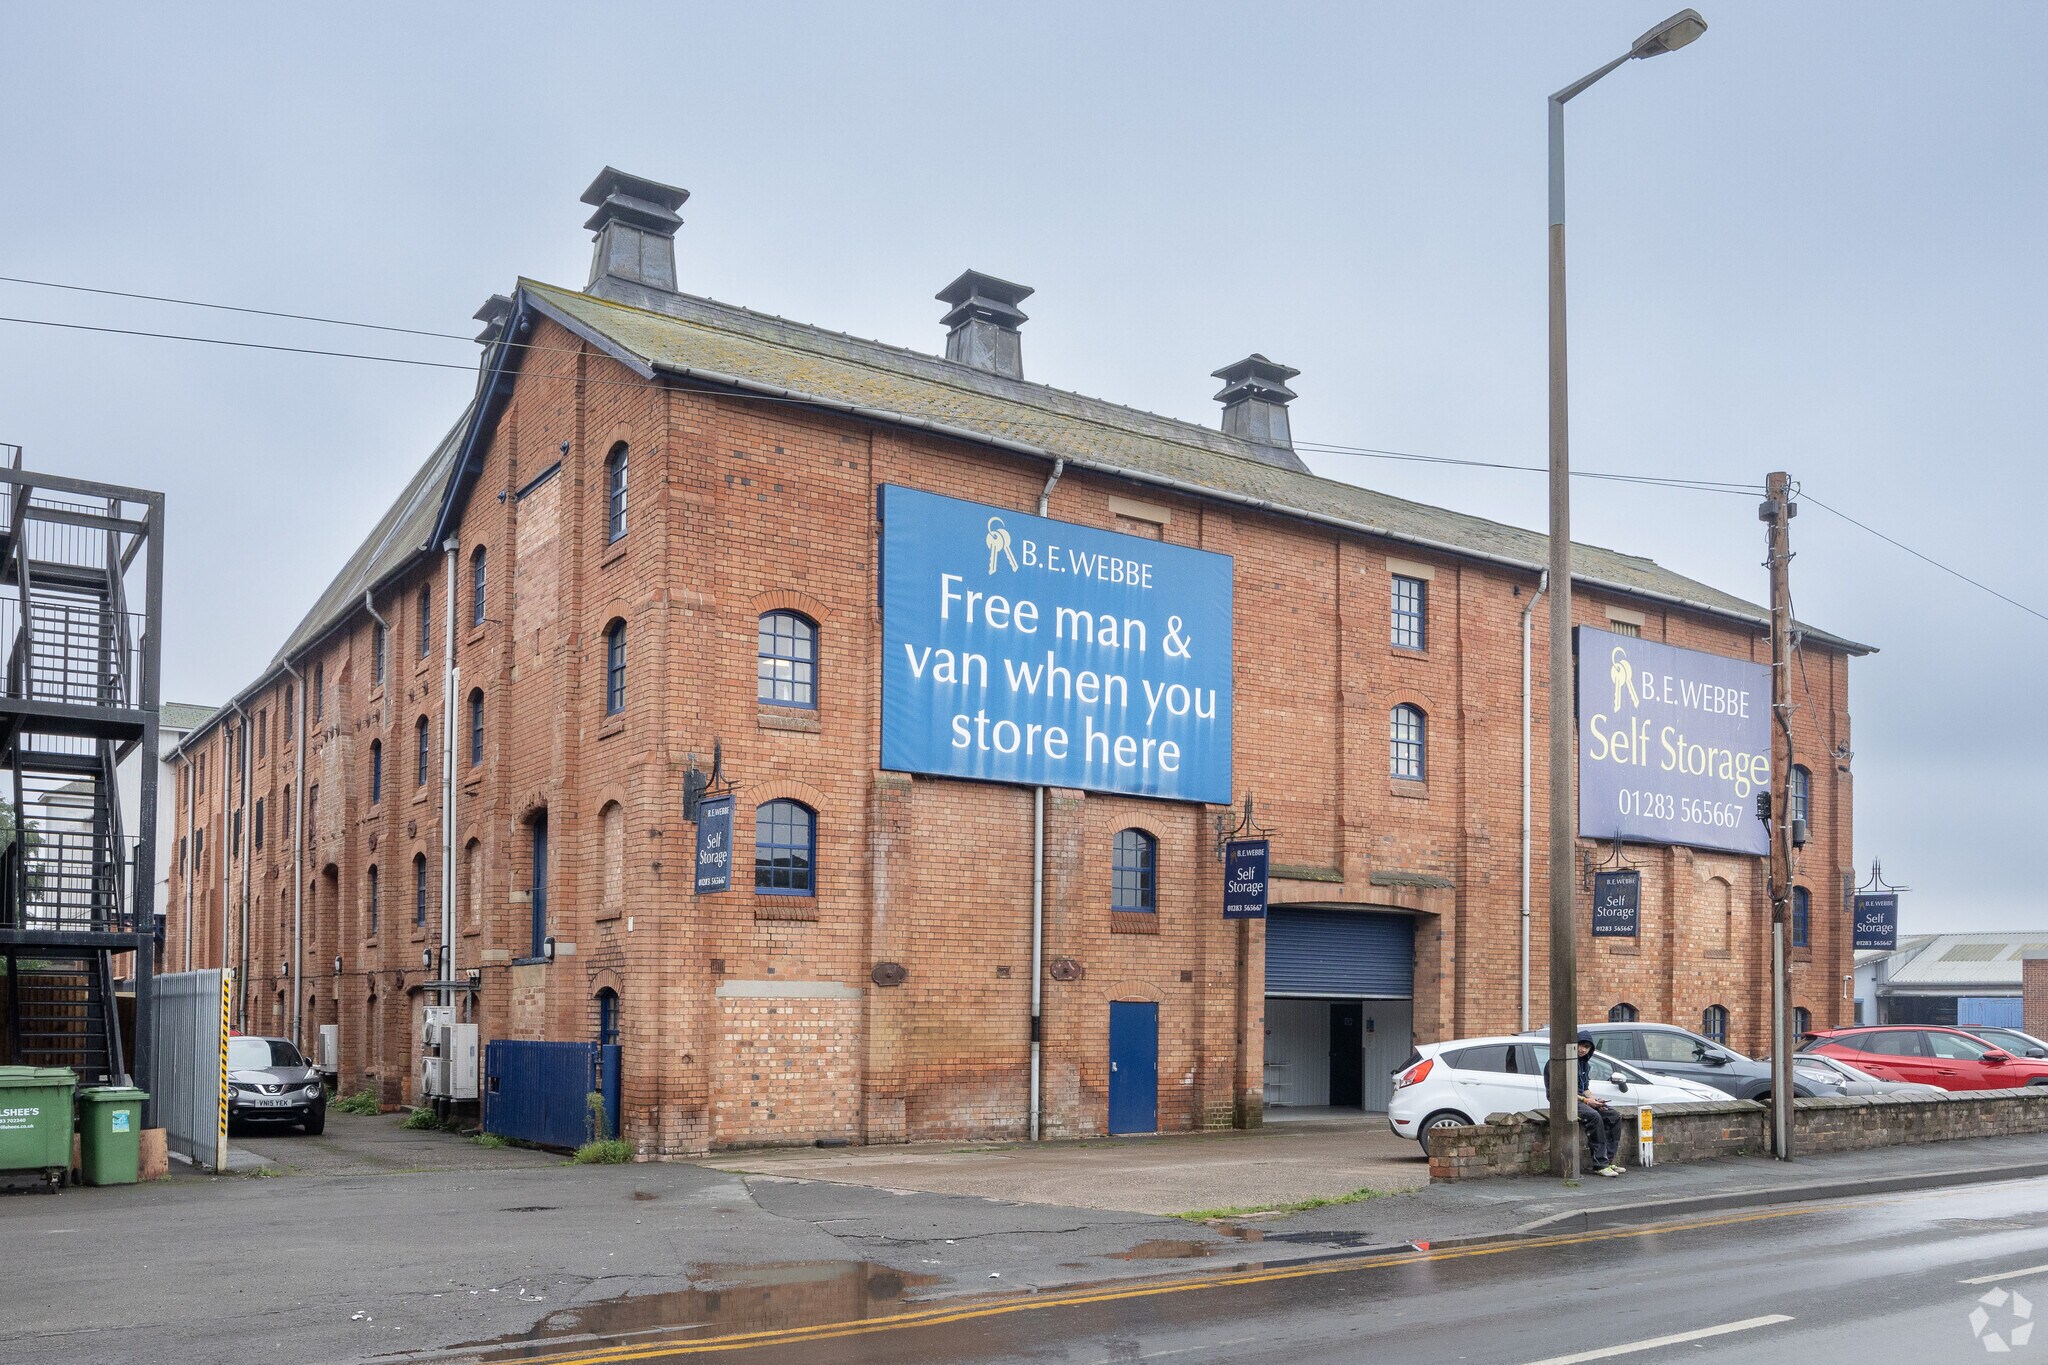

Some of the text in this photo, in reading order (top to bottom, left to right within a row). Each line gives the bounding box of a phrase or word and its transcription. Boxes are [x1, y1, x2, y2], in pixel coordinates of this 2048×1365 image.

[941, 573, 1192, 659] Free man &
[904, 643, 1216, 726] van when you
[951, 708, 1180, 772] store here
[1590, 713, 1770, 798] Self Storage
[1618, 788, 1743, 829] 01283 565667
[706, 832, 722, 849] Self
[699, 849, 728, 868] Storage
[1237, 866, 1256, 880] Self
[1228, 880, 1263, 897] Storage
[1606, 895, 1625, 906] Self
[1597, 906, 1634, 920] Storage
[1866, 913, 1885, 923] Self
[1857, 923, 1893, 935] Storage
